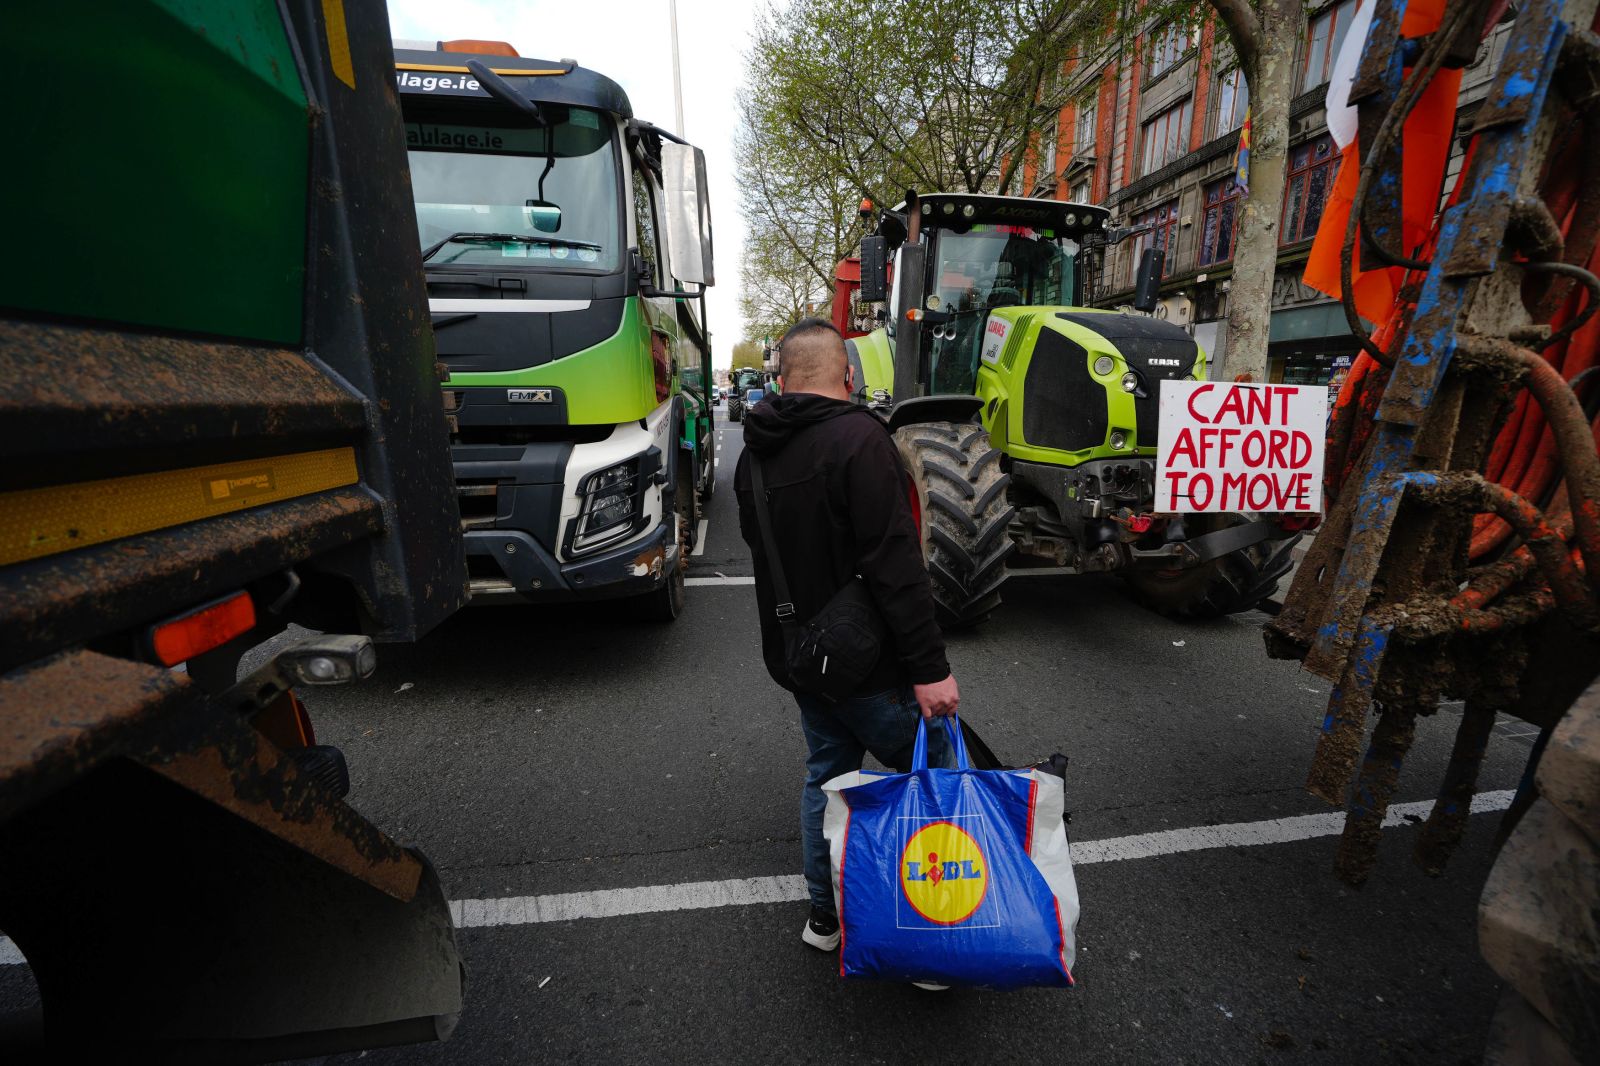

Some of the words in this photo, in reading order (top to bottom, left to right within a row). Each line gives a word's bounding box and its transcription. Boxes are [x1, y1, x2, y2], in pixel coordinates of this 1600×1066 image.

[1149, 358, 1180, 367] CLAAS
[1187, 384, 1299, 425] CANT
[1165, 427, 1312, 469] AFFORD
[1165, 471, 1214, 511] TO
[1219, 472, 1313, 511] MOVE
